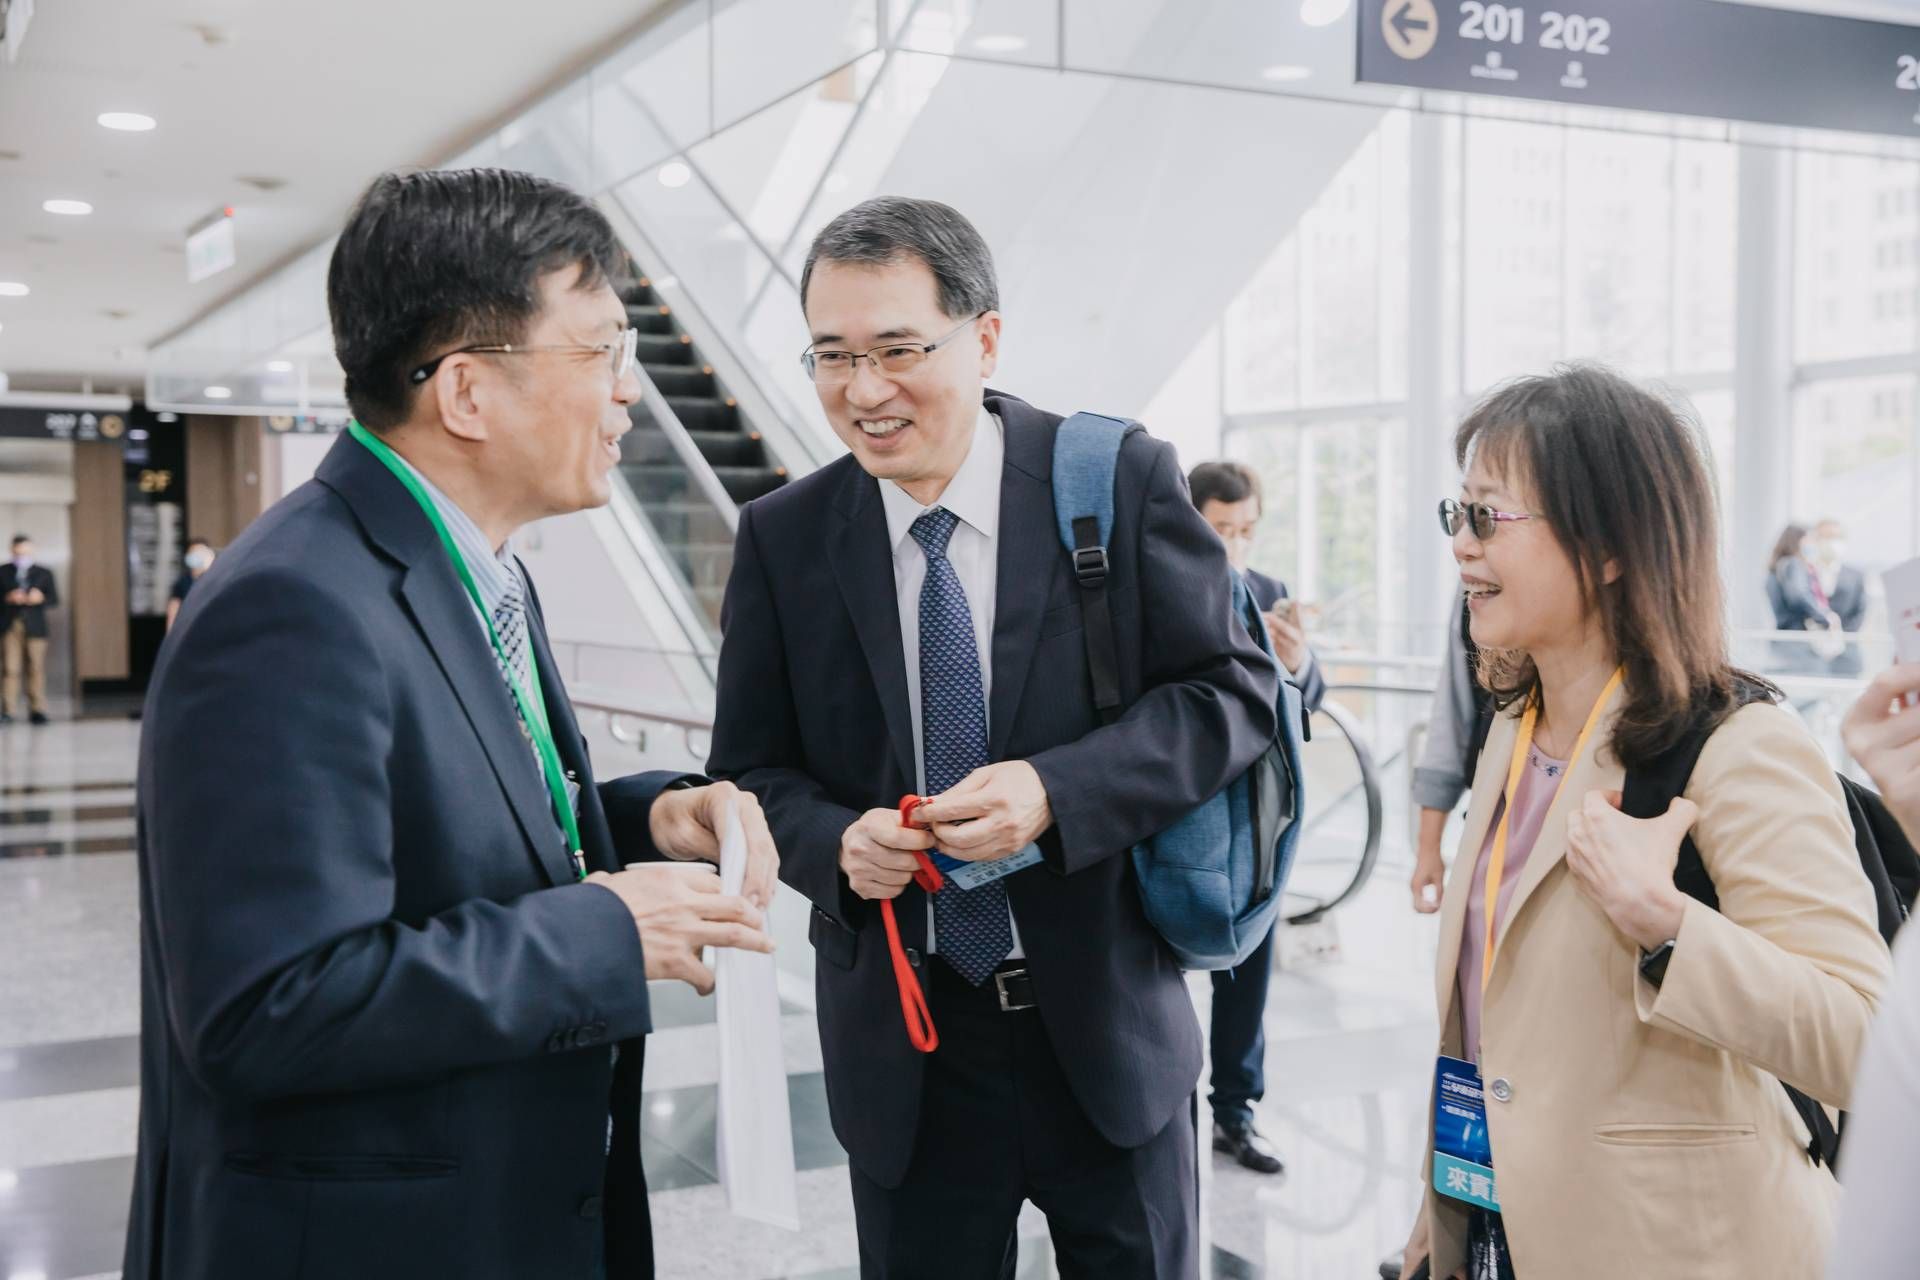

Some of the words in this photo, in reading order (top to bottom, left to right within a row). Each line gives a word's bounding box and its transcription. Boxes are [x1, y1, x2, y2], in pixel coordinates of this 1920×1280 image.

[1459, 1, 1524, 44] 201
[1539, 11, 1611, 55] 202
[1896, 54, 1920, 90] 2
